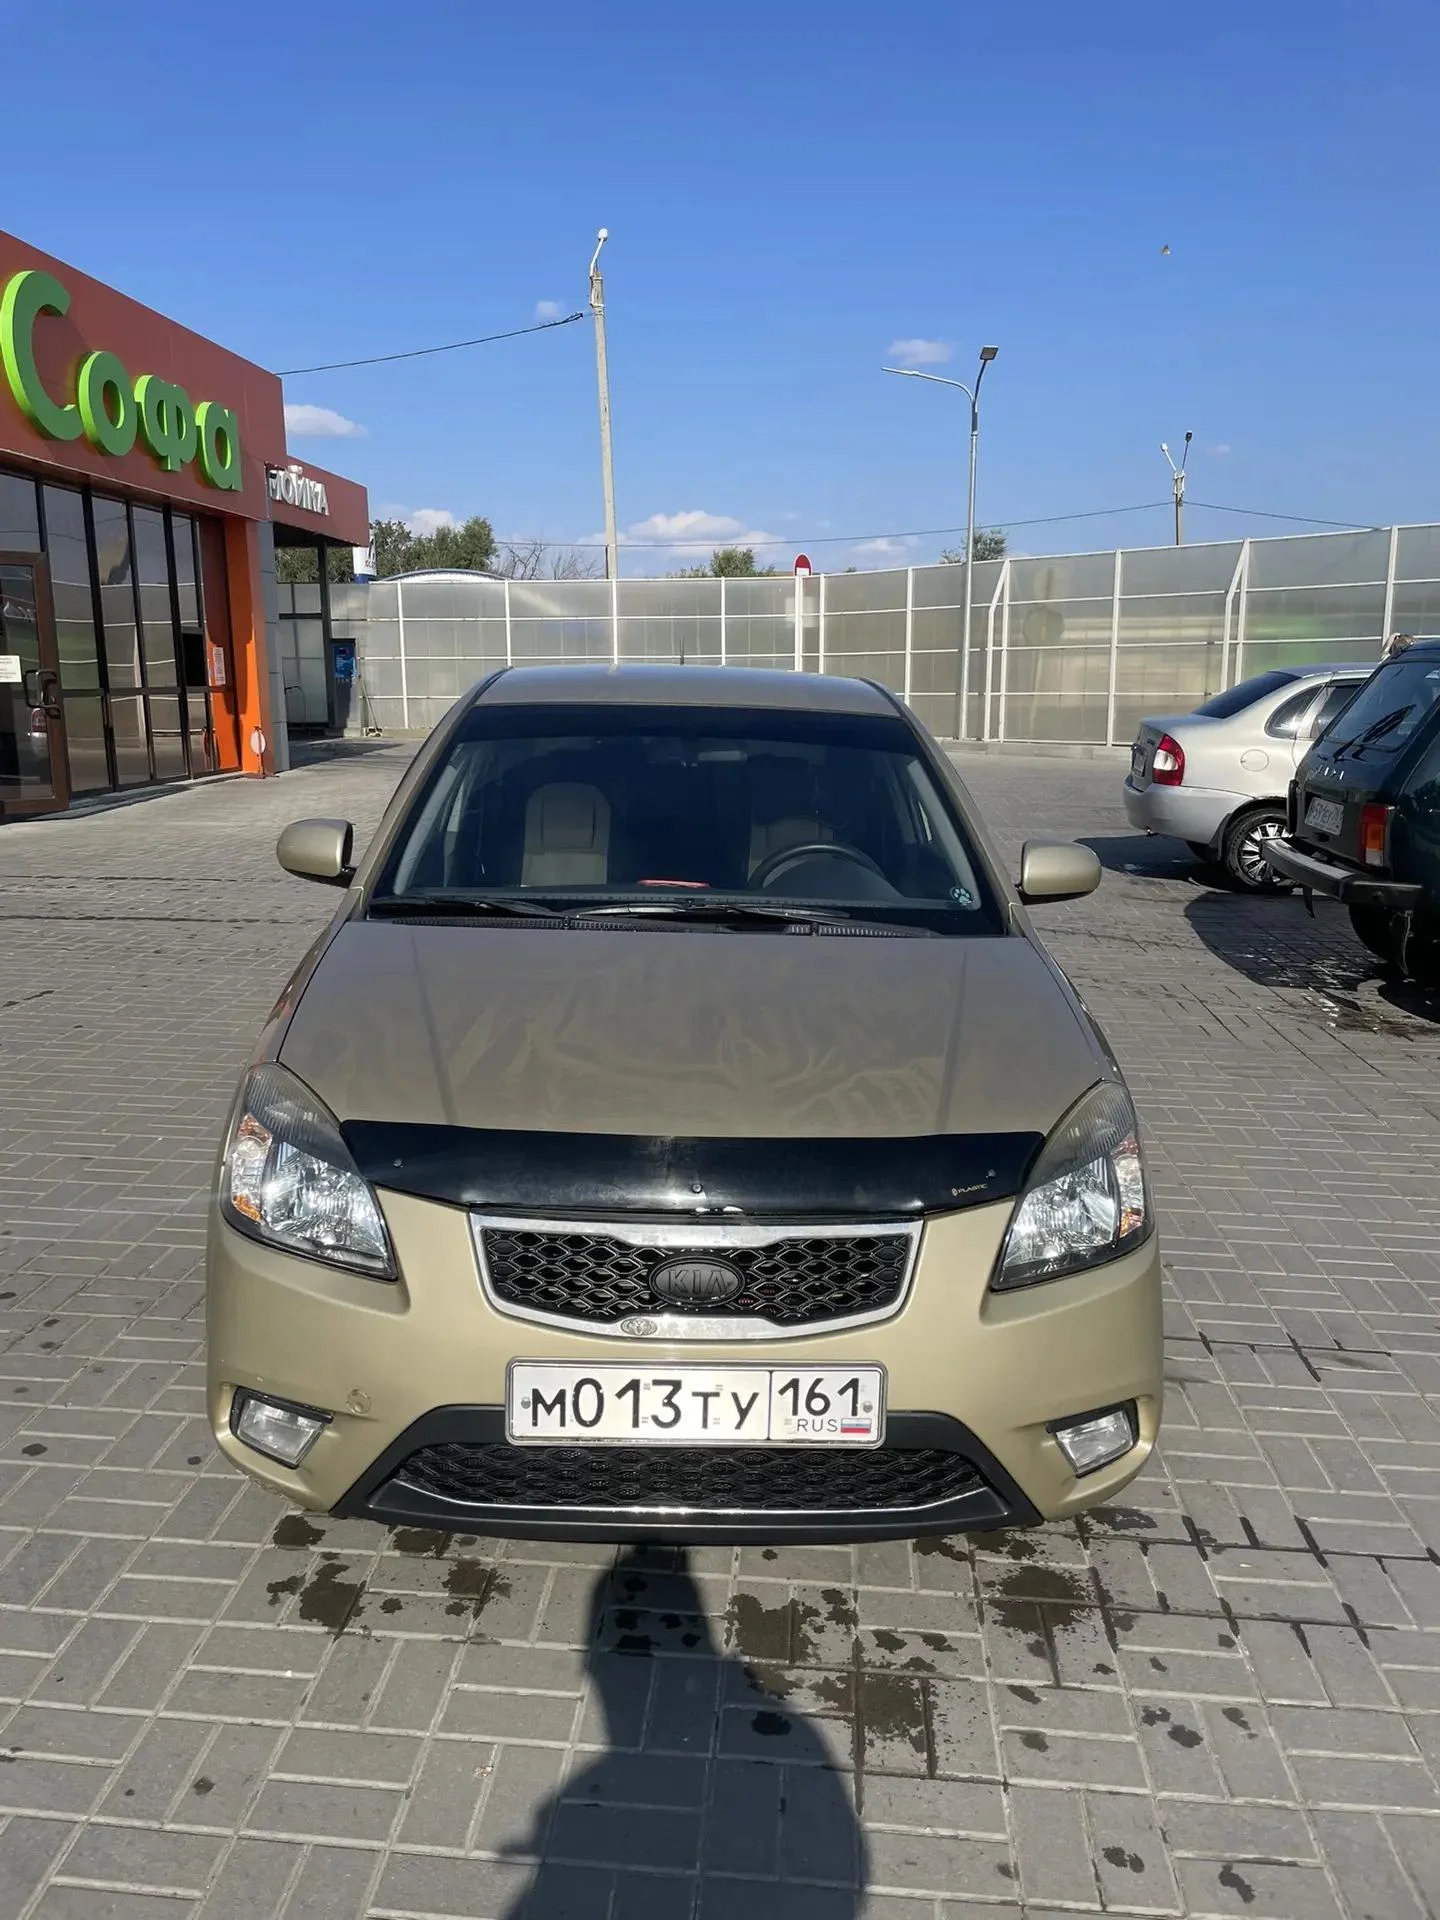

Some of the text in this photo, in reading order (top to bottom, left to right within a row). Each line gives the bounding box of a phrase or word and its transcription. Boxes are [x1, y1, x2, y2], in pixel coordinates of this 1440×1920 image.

[1, 271, 243, 491] Софа
[269, 465, 329, 515] МОЙКА
[667, 1269, 727, 1294] KIA
[778, 1378, 859, 1416] 161
[797, 1418, 838, 1432] RUS
